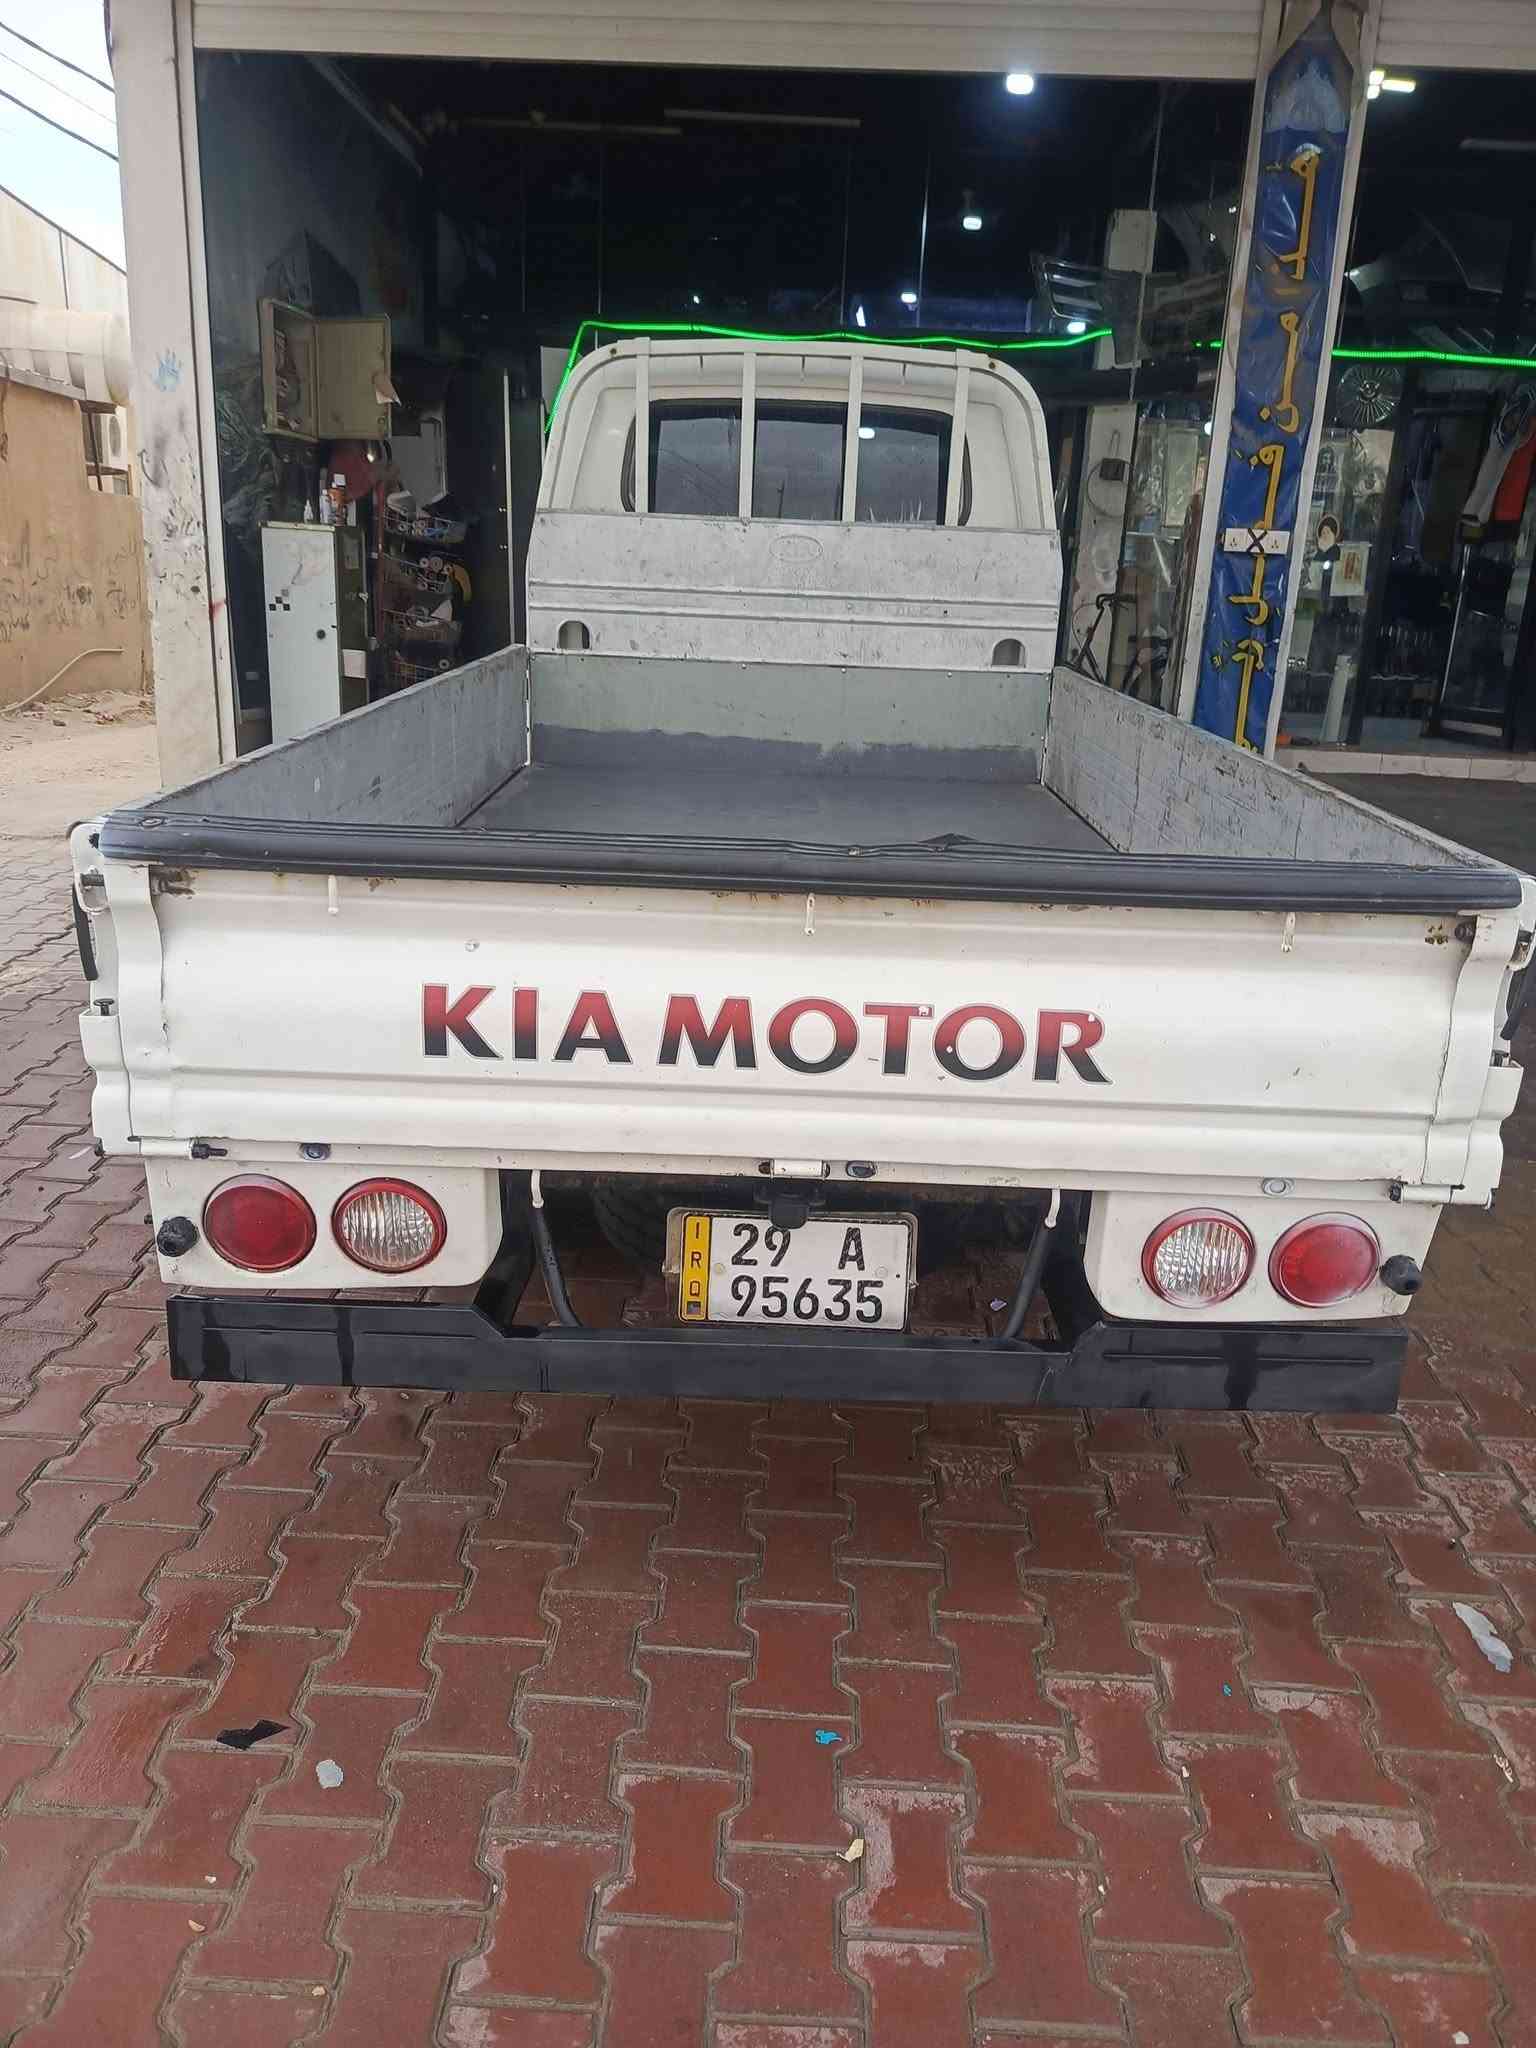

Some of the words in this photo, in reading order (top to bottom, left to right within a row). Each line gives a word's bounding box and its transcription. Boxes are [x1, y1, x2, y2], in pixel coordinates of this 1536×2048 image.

[1259, 312, 1300, 433] من
[421, 983, 634, 1066] KIA
[656, 993, 1113, 1085] MOTOR
[731, 1223, 791, 1267] 29
[838, 1227, 865, 1271] A
[730, 1275, 884, 1323] 95635
